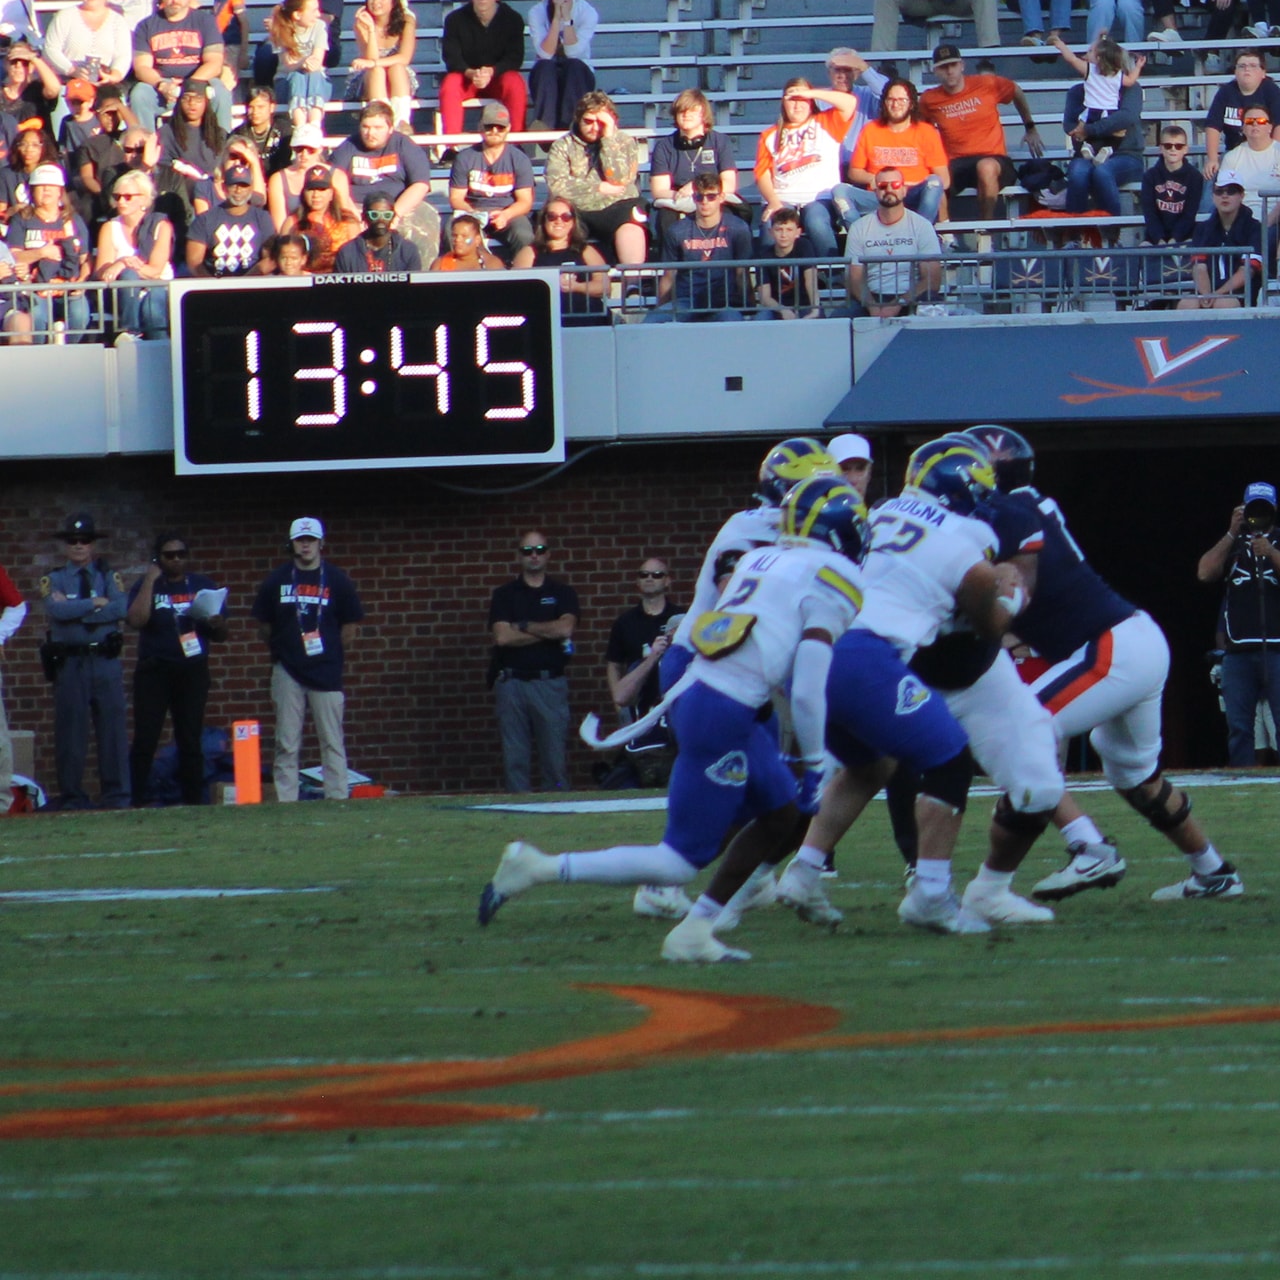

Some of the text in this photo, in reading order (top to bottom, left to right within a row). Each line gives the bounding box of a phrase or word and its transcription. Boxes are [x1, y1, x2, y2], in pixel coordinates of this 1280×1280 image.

[151, 29, 202, 52] VIRGINIA
[938, 97, 982, 114] VIRGINIA
[683, 236, 729, 250] VIRGINIA
[865, 237, 914, 249] CAVALIERS
[315, 273, 409, 286] DAKTRONICS
[245, 315, 536, 426] 13:45
[748, 554, 781, 572] ALI
[721, 578, 761, 608] 2
